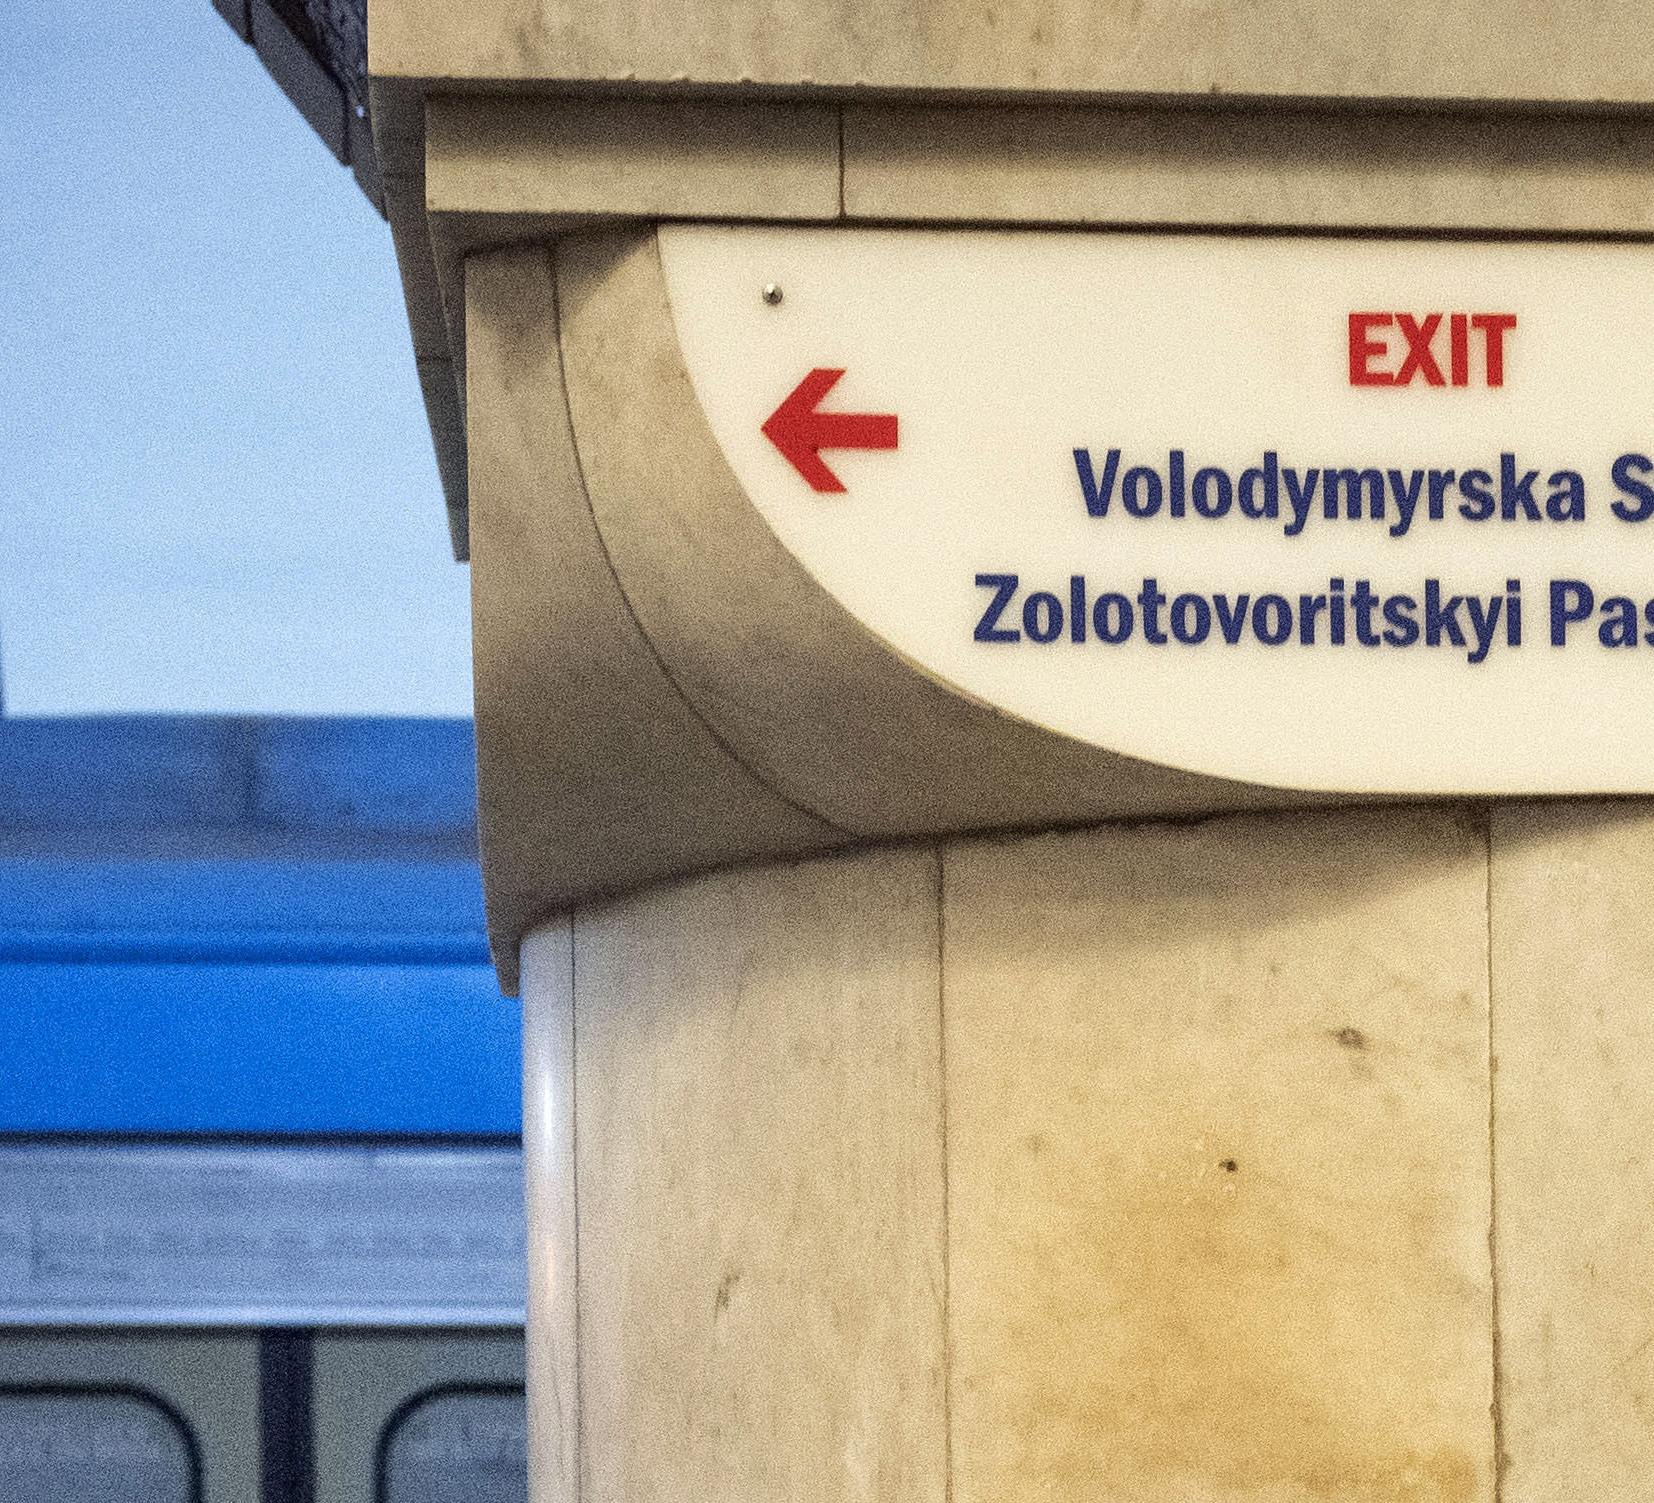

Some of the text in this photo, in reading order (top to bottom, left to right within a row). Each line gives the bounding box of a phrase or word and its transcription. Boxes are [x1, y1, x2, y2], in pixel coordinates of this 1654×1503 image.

[1348, 313, 1517, 387] EXIT
[1073, 449, 1586, 537] Volodymyrska
[974, 574, 1523, 664] Zolotovoritskyi
